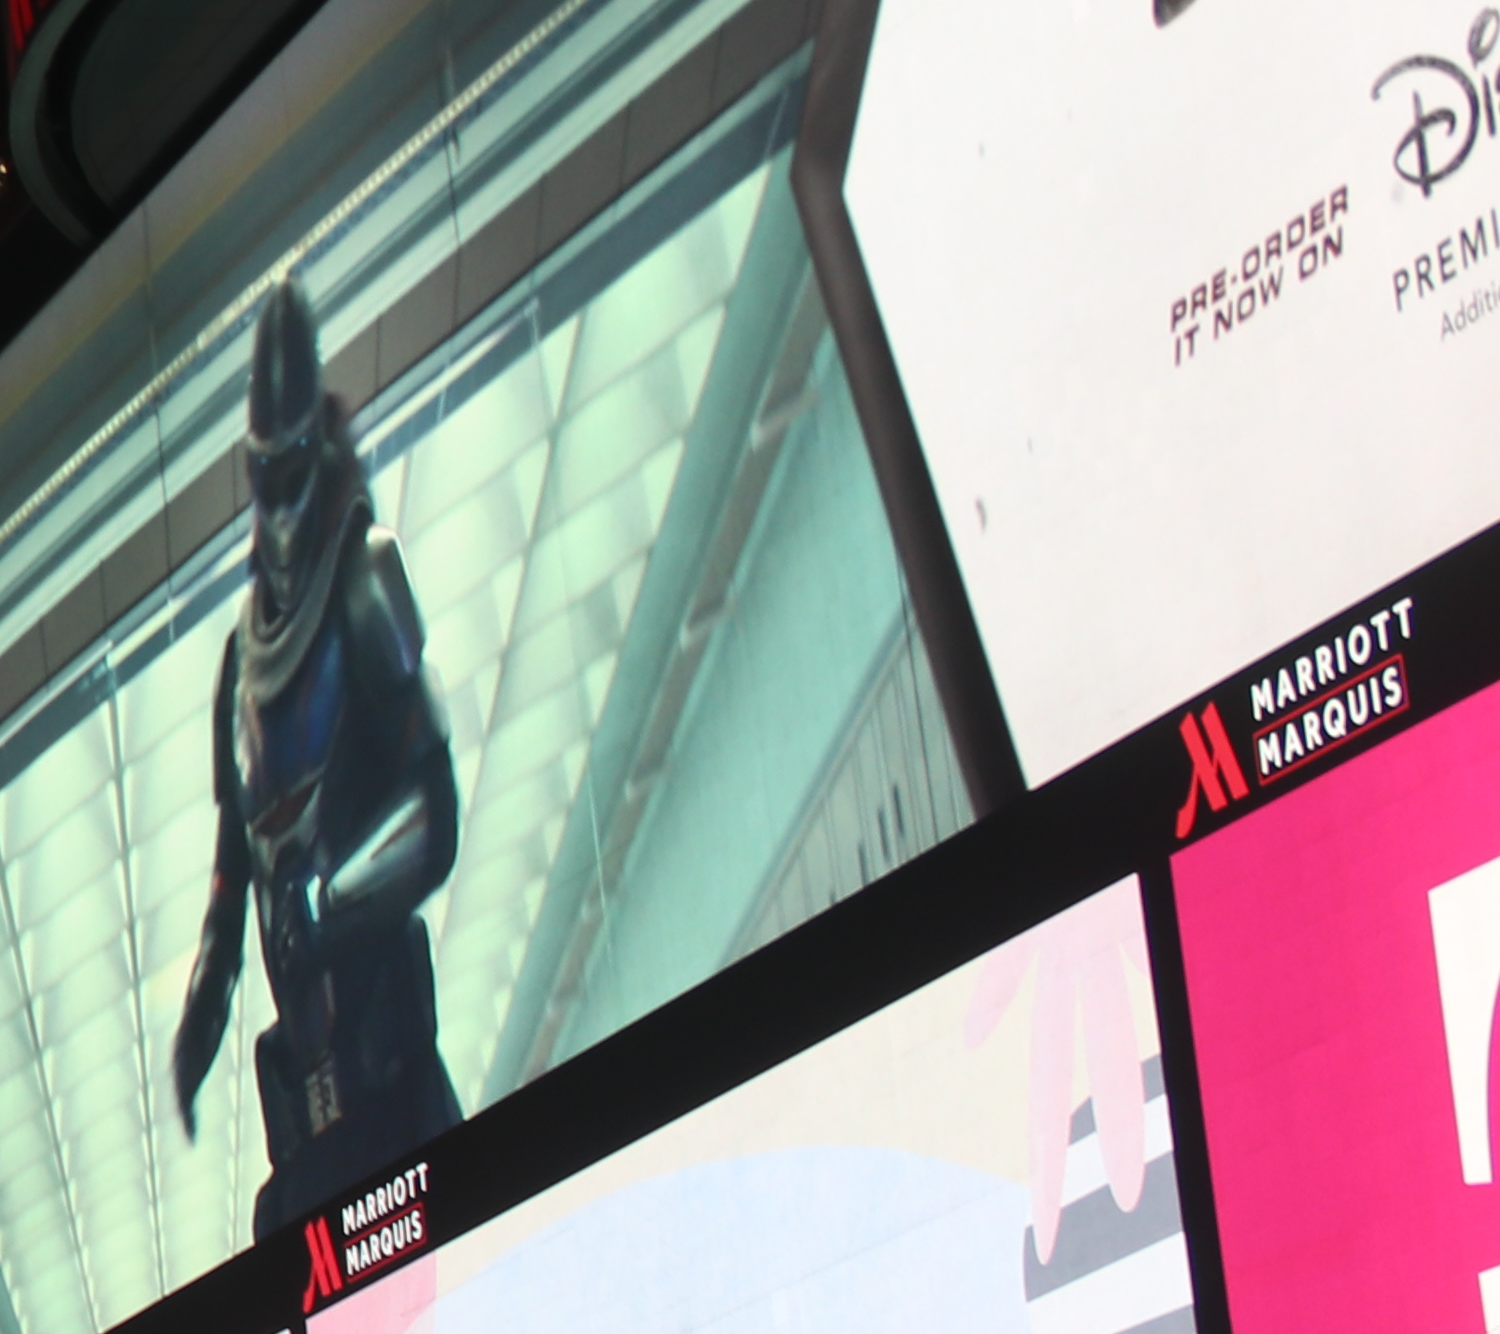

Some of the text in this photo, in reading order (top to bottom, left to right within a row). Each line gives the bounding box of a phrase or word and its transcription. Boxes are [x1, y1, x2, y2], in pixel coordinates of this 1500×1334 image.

[1171, 183, 1349, 334] PRE-ORDER
[1174, 224, 1345, 367] IT NOW ON
[1250, 596, 1415, 721] MARRIOTT
[1256, 663, 1404, 776] MARQUIS
[341, 1161, 429, 1238] MARRIOTT
[346, 1210, 424, 1275] MARQUIS
